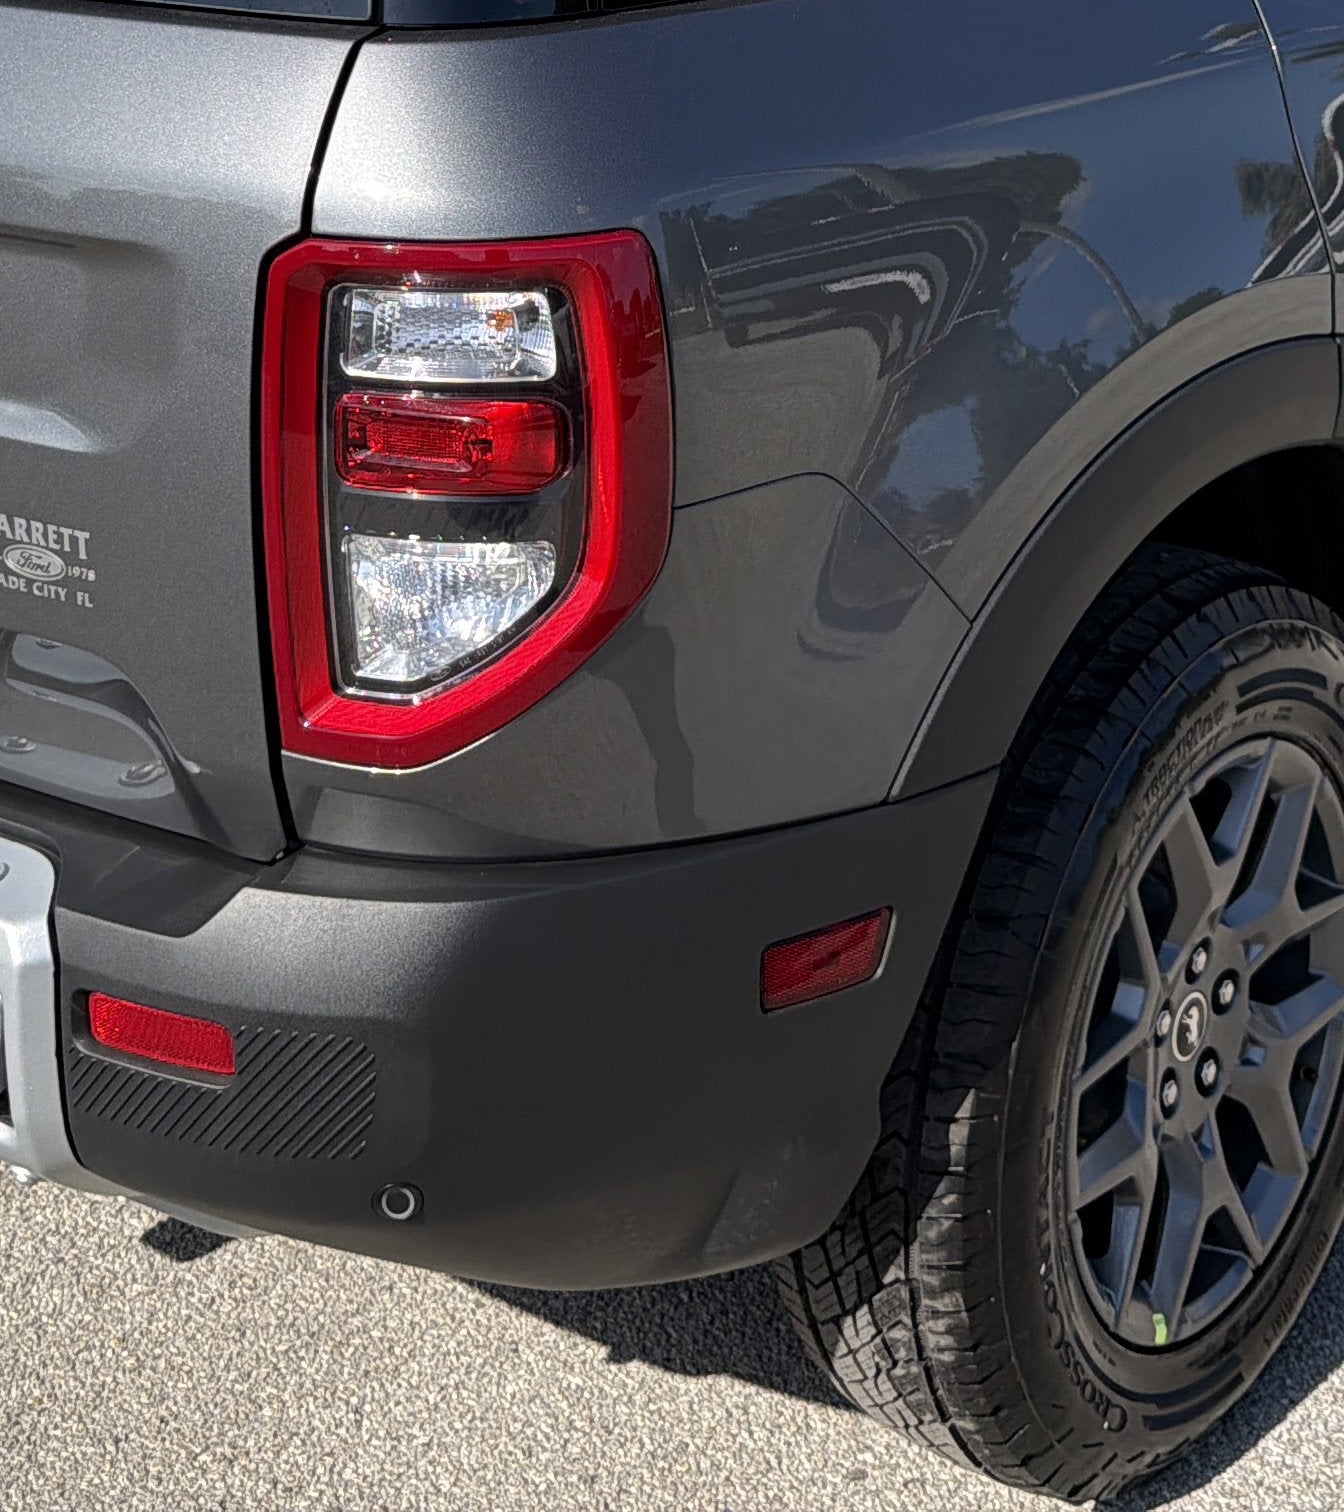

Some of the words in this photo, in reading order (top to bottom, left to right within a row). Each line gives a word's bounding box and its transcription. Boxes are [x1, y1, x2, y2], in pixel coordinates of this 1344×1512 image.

[17, 551, 52, 574] Ford
[32, 582, 67, 602] CITY
[76, 591, 94, 608] FL
